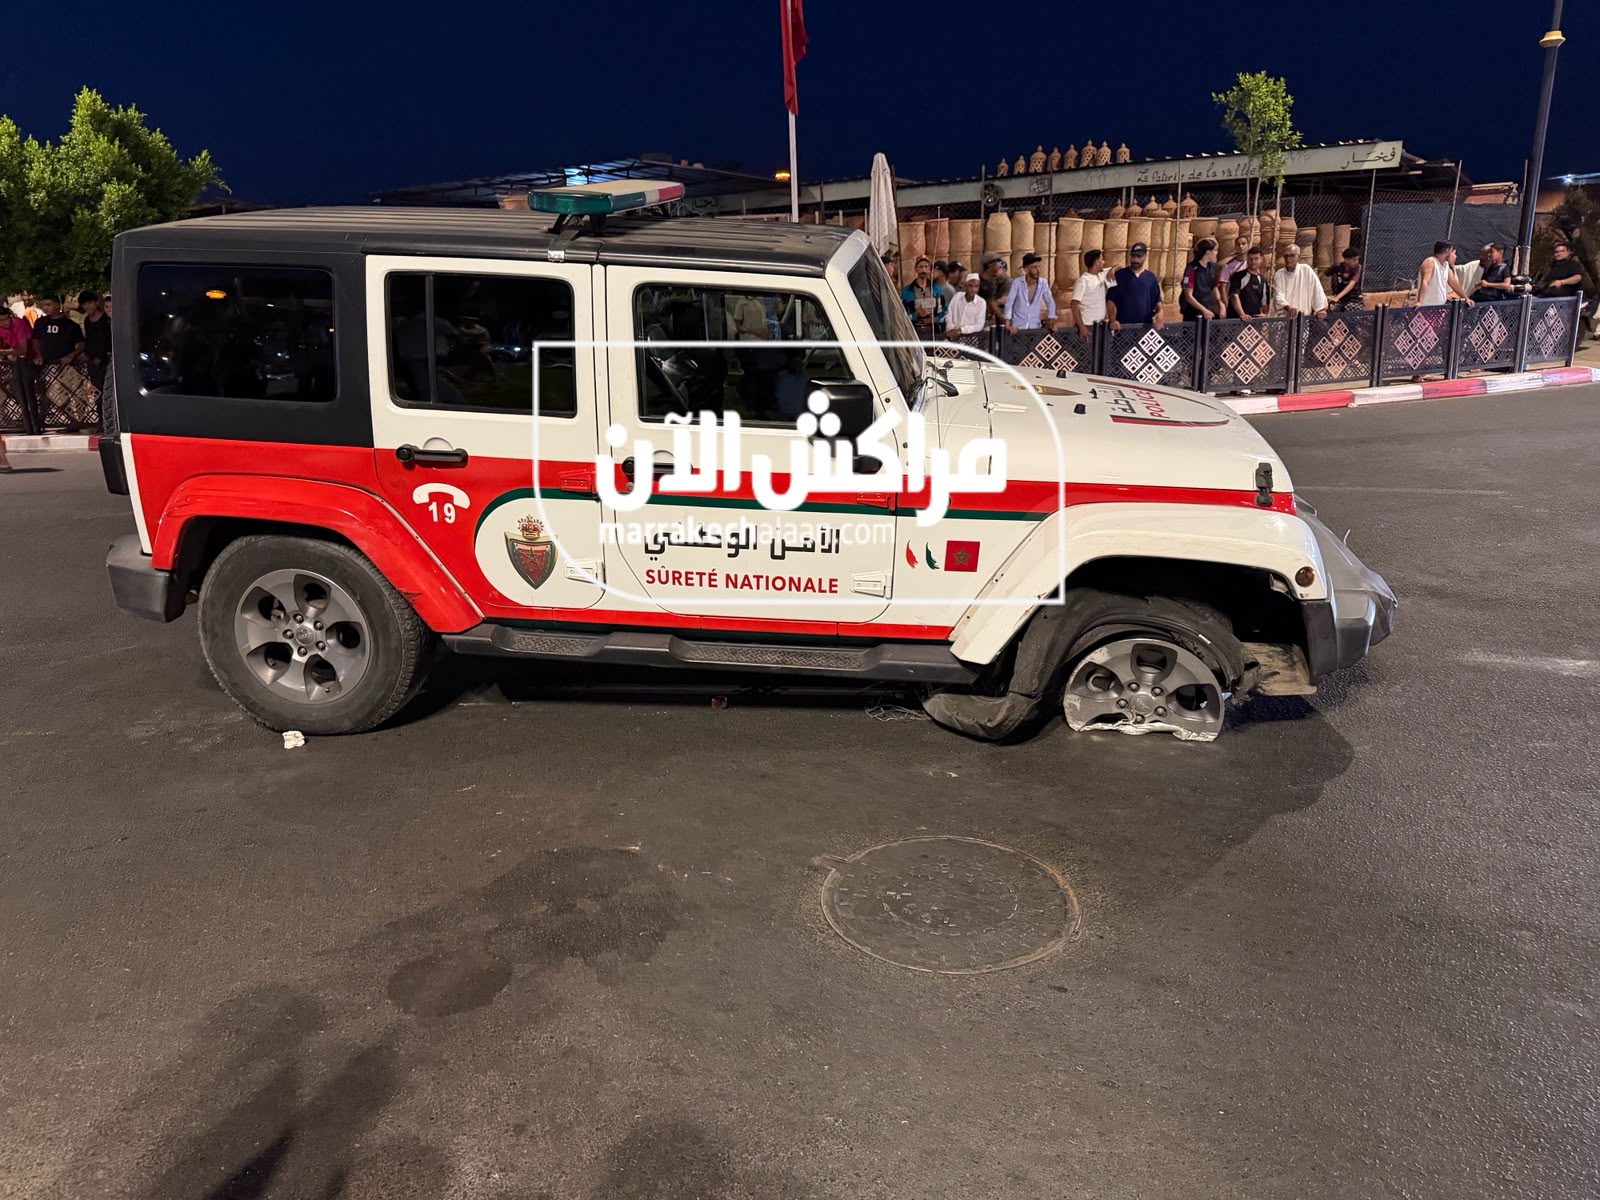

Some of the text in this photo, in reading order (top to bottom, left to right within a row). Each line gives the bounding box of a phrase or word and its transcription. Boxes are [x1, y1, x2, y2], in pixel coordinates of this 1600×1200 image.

[1188, 168, 1202, 179] de
[46, 325, 58, 333] 10
[1131, 390, 1171, 419] POLICE
[428, 501, 456, 524] 19
[645, 566, 839, 594] SÛRETÉ NATIONALE
